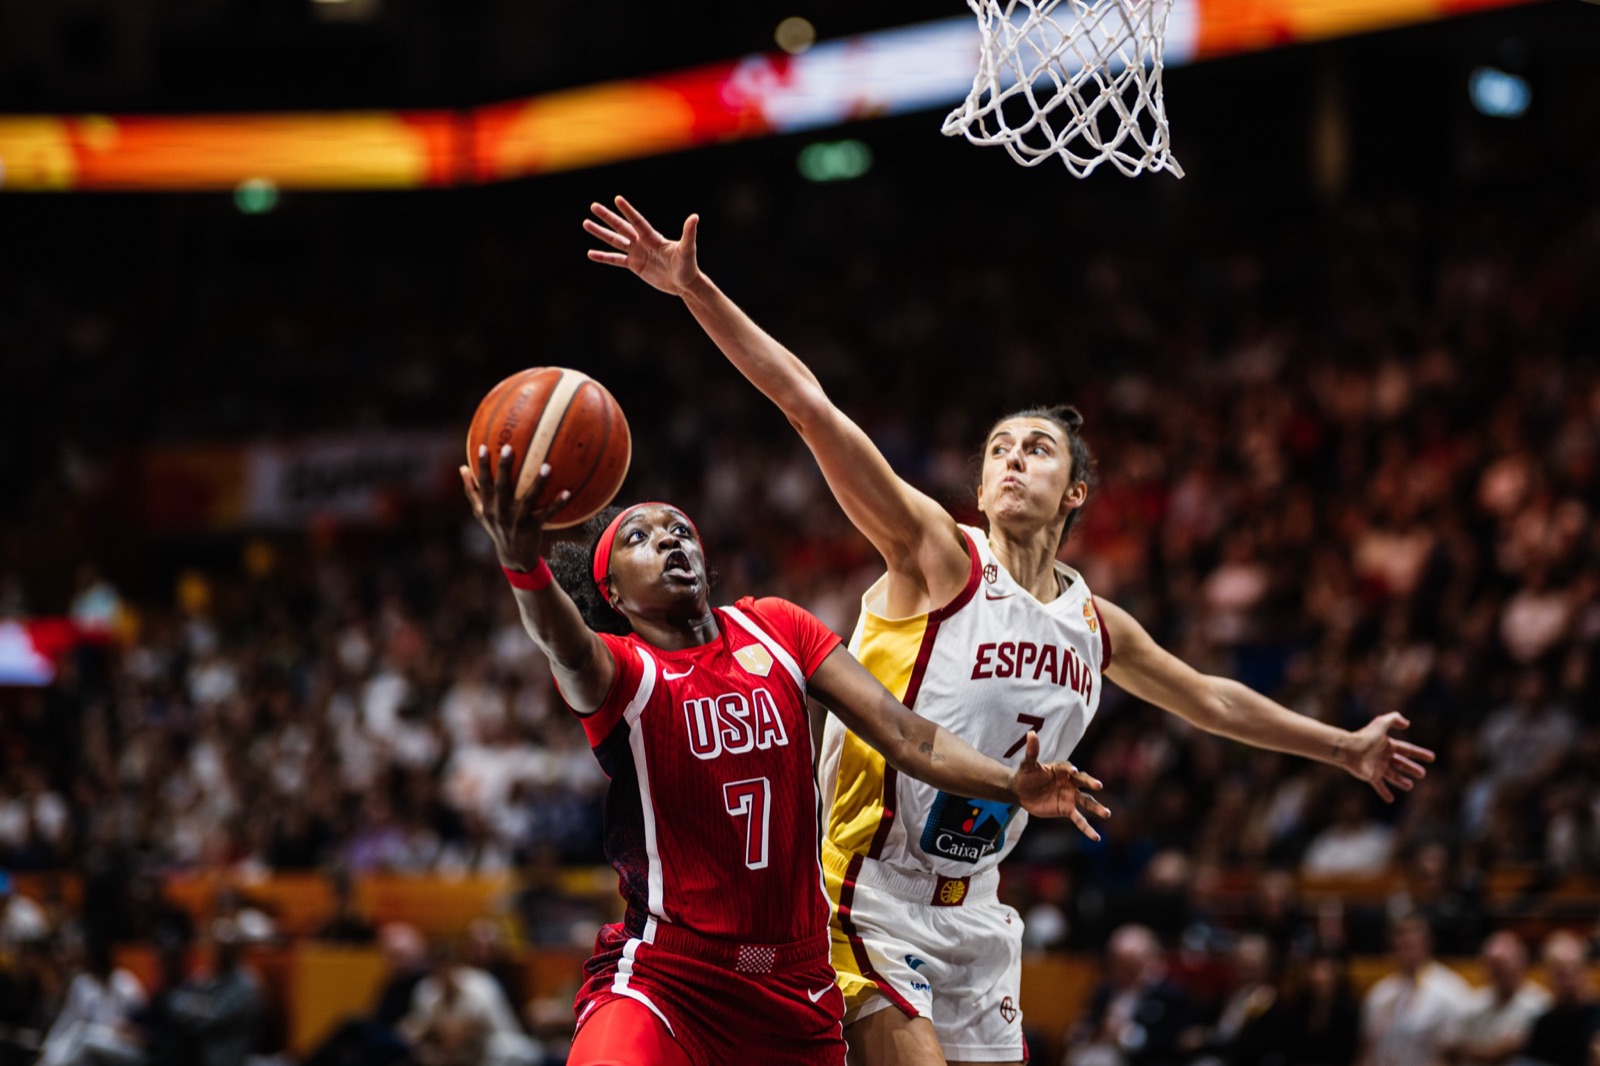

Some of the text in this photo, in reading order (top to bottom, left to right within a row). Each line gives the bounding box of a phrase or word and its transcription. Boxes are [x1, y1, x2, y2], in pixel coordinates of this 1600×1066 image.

[970, 641, 1092, 707] ESPAÑA
[683, 687, 789, 760] USA
[1003, 712, 1045, 759] 7
[722, 776, 771, 870] 7
